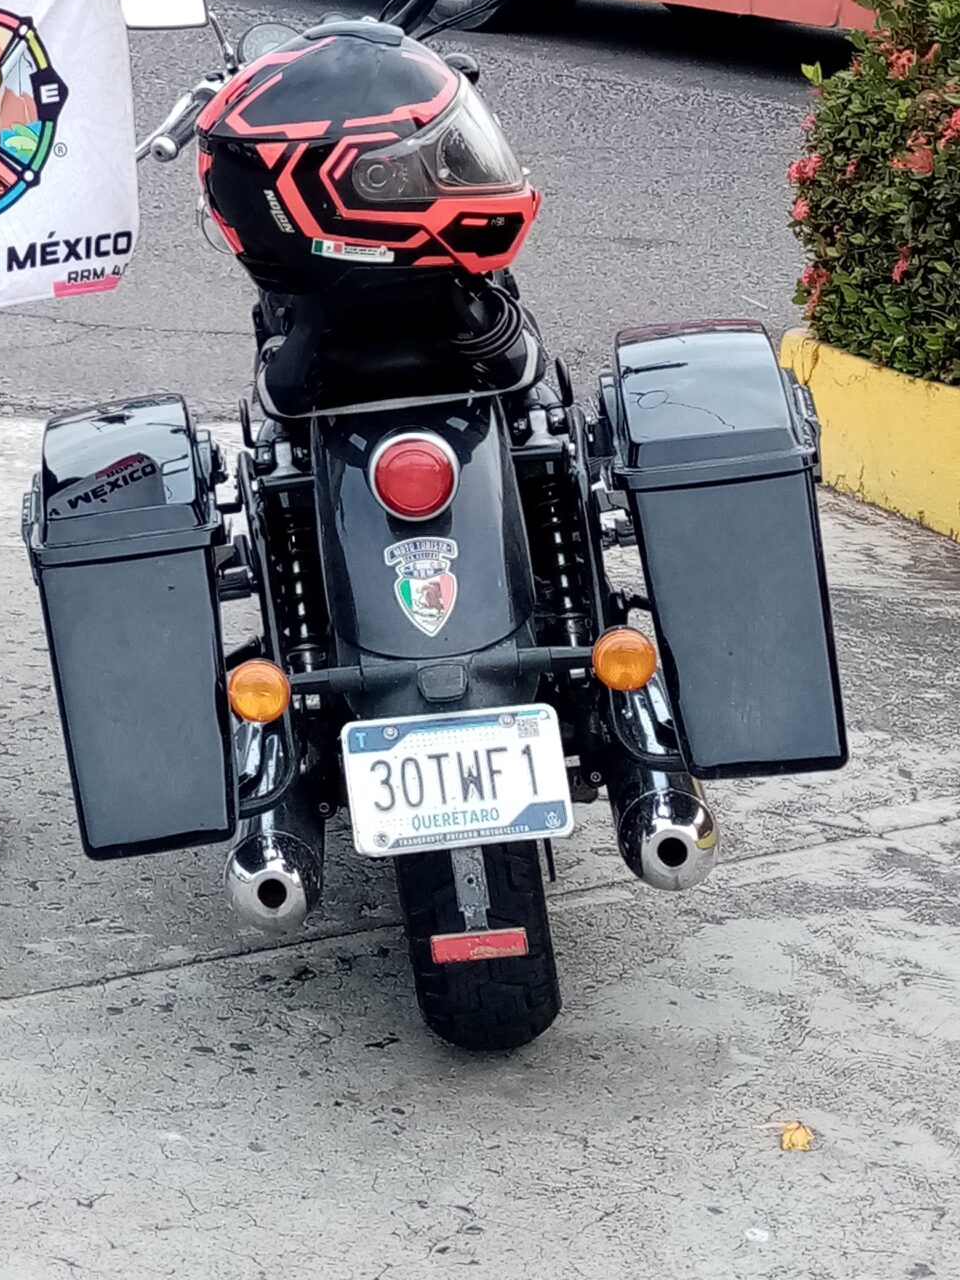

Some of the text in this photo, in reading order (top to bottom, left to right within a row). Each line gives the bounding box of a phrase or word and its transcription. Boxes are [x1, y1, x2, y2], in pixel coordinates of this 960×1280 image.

[41, 84, 60, 104] E
[263, 189, 295, 234] NOLAN
[6, 230, 132, 272] MÉXICO
[67, 267, 105, 283] RRM
[354, 731, 368, 749] T
[411, 806, 500, 831] QUERÉTARO
